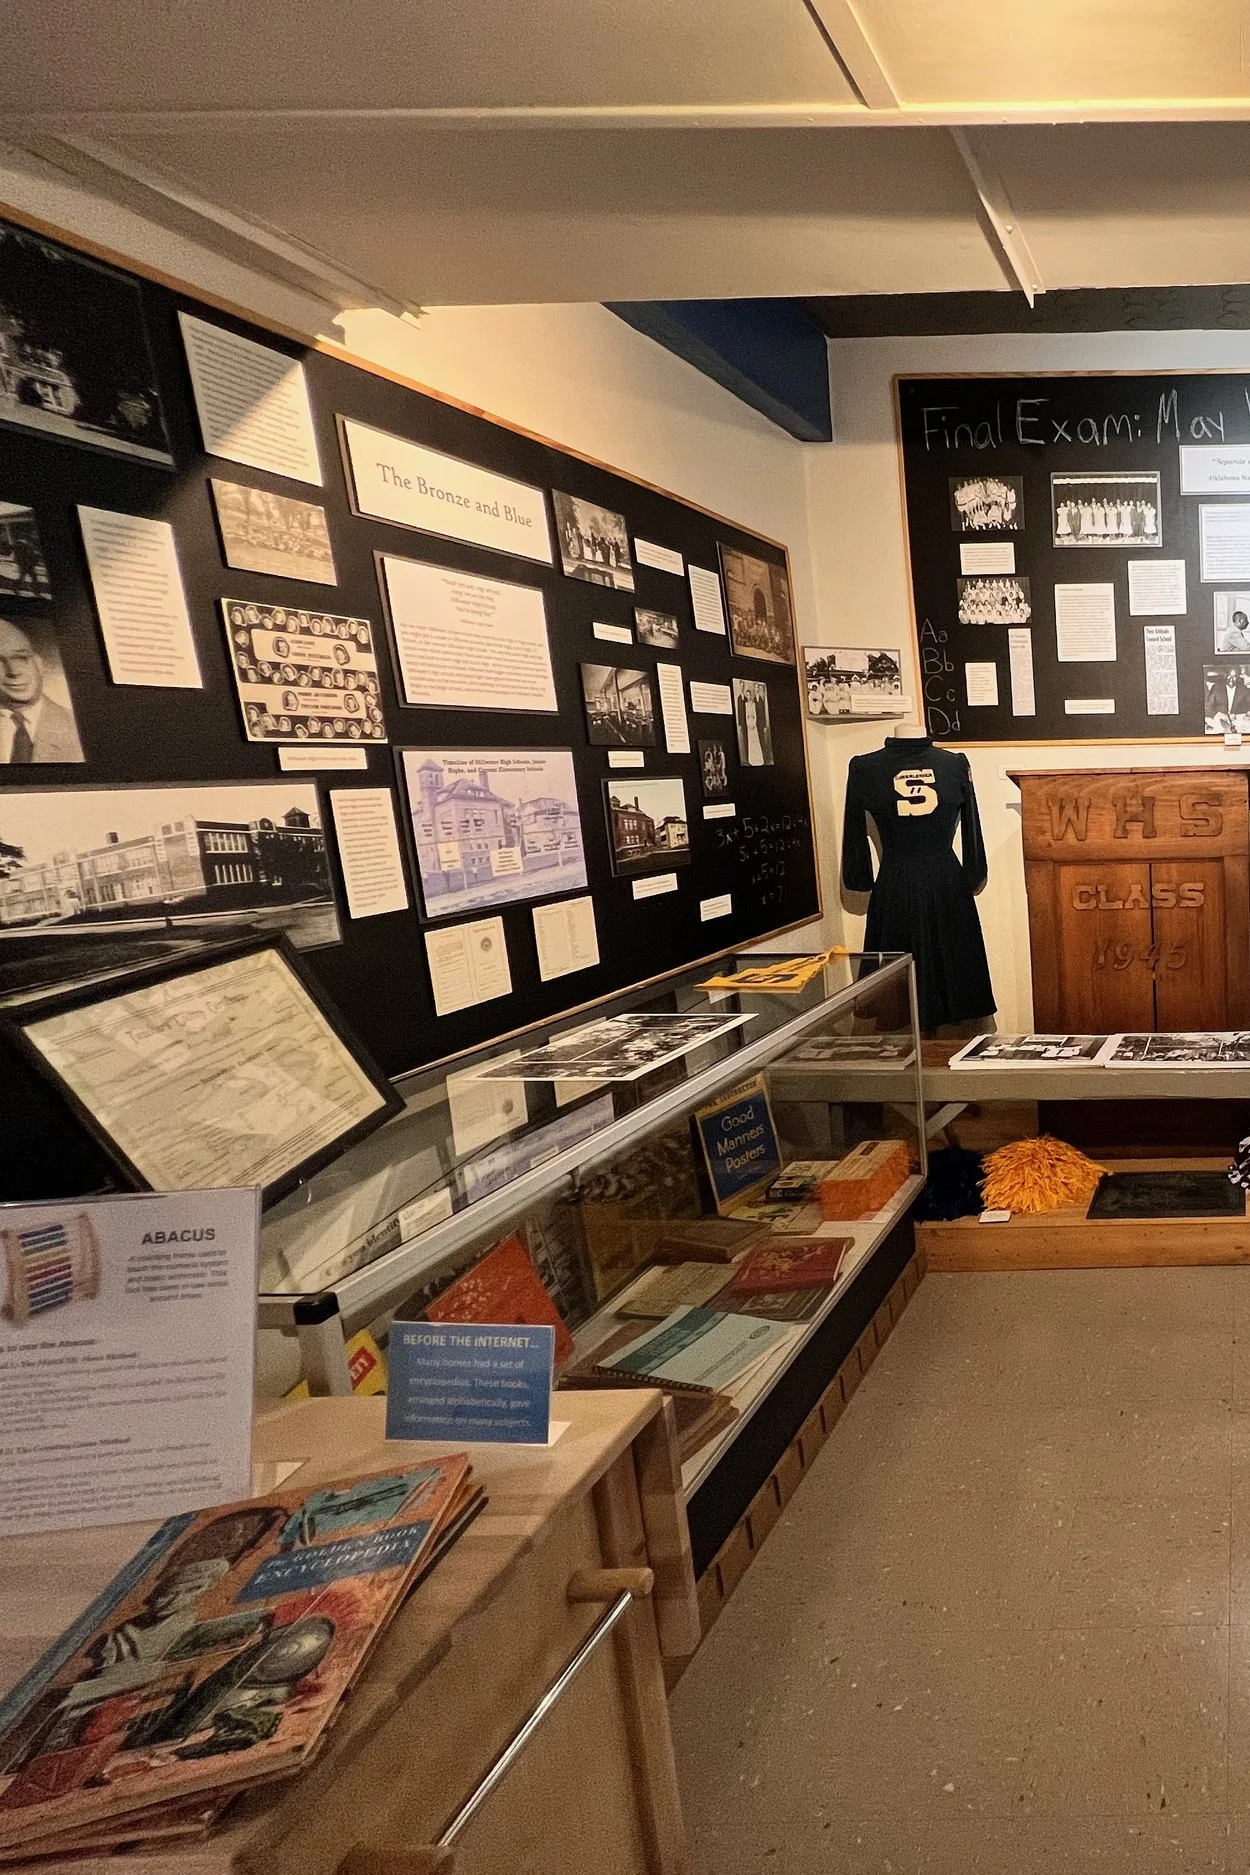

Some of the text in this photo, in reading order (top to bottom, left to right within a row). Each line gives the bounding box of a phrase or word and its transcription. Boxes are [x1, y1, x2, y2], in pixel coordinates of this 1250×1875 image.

[921, 400, 1001, 450] Final
[1017, 399, 1141, 447] Exam:
[1156, 389, 1225, 443] May
[376, 462, 533, 528] The Bronze and Blue
[920, 618, 948, 643] Aa
[922, 647, 954, 674] Bb
[925, 675, 955, 702] Cc
[928, 706, 960, 735] Dd
[893, 769, 939, 817] S
[1072, 882, 1205, 910] CLASS
[1093, 940, 1190, 972] 1945
[721, 1104, 755, 1132] Good
[716, 1123, 766, 1157] Manners
[725, 1143, 766, 1174] Posters
[141, 1228, 216, 1246] ABACUS
[403, 1334, 447, 1347] BEFORE
[449, 1335, 472, 1347] THE
[416, 1357, 440, 1370] Many
[474, 1358, 490, 1369] had
[500, 1359, 513, 1369] set
[515, 1359, 525, 1370] of
[474, 1378, 500, 1388] These
[254, 1539, 412, 1585] ENCYCLOPEDIA
